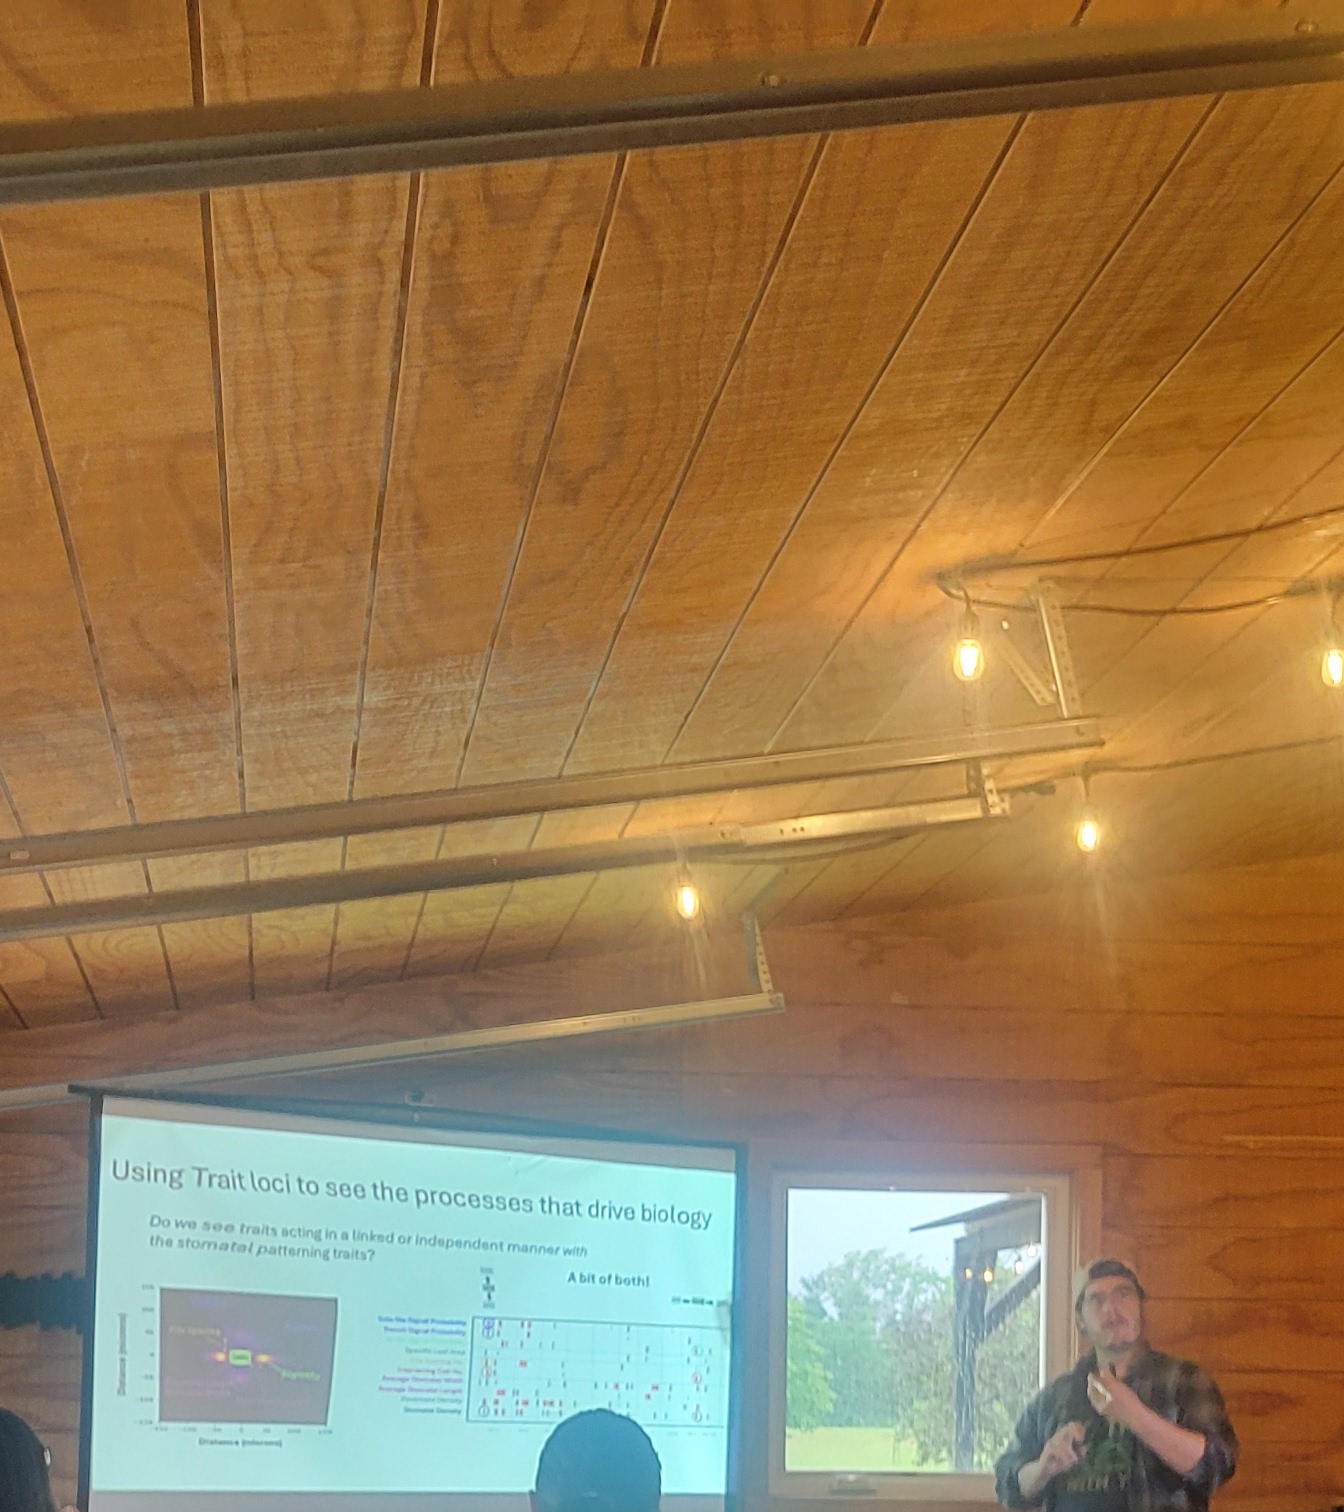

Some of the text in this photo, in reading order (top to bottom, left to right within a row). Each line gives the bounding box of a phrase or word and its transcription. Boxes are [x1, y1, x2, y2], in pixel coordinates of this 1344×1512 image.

[112, 1159, 713, 1231] Using Trait loci to see the processes that drive biology
[149, 1214, 588, 1258] Do we see traits acting in a linked or independent manner with
[149, 1234, 375, 1262] the stomatal patterning traits?
[567, 1271, 650, 1288] A bit of both!
